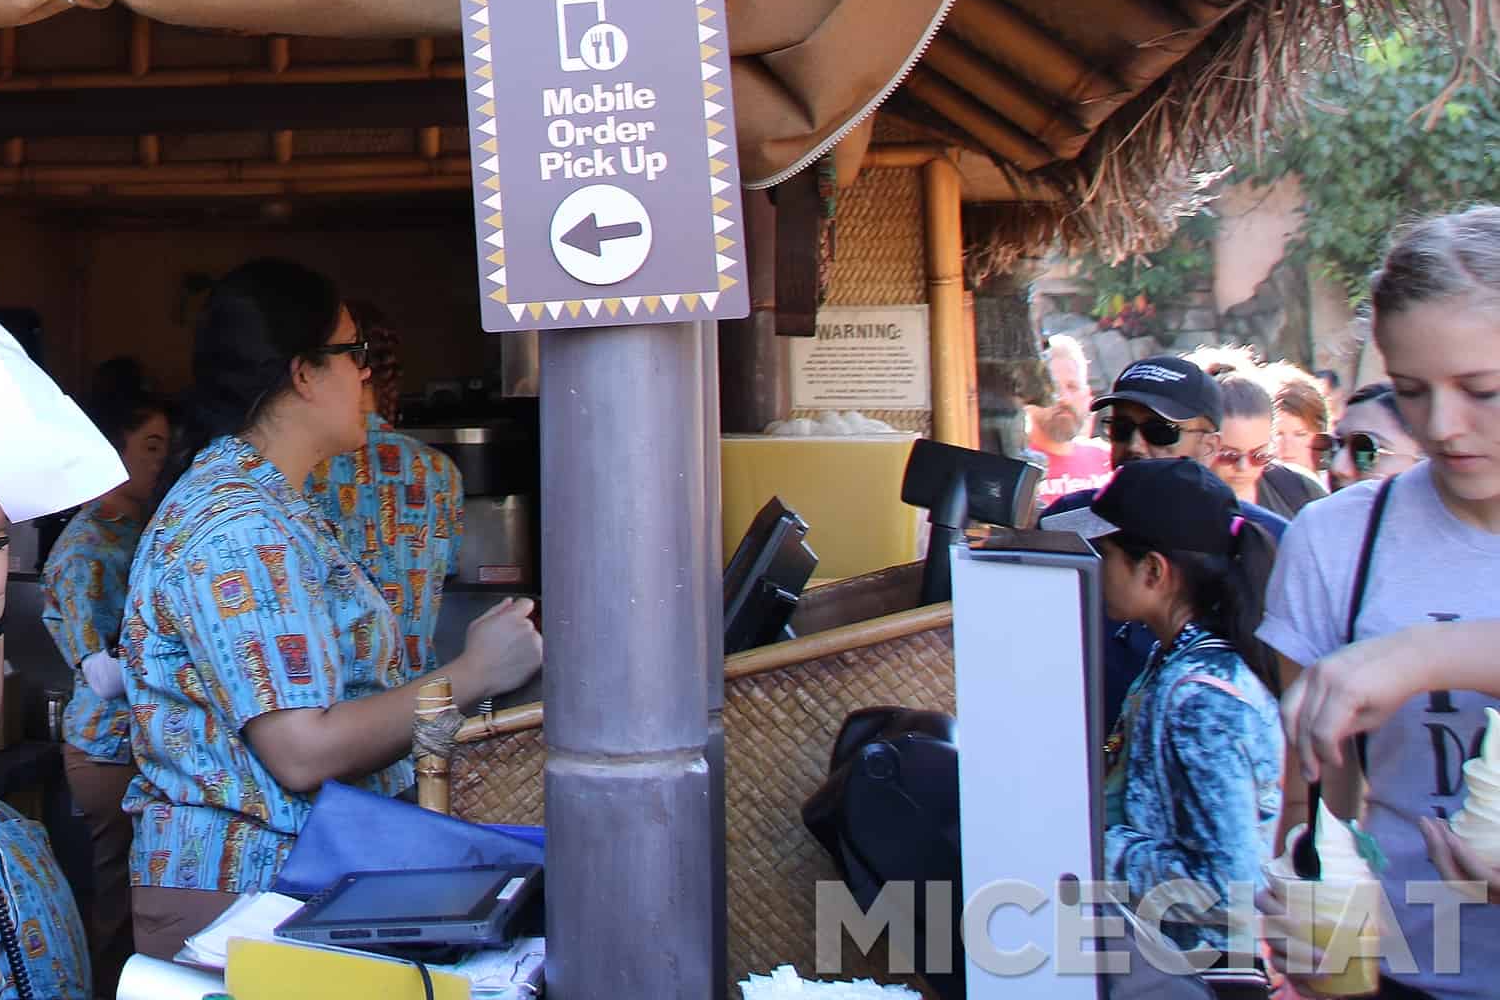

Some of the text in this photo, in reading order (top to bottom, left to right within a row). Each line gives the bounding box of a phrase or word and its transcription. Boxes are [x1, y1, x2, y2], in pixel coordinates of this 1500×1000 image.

[542, 82, 657, 117] Mobile
[547, 116, 655, 148] Order
[539, 146, 668, 181] Pick Up
[815, 323, 902, 340] WARNING
